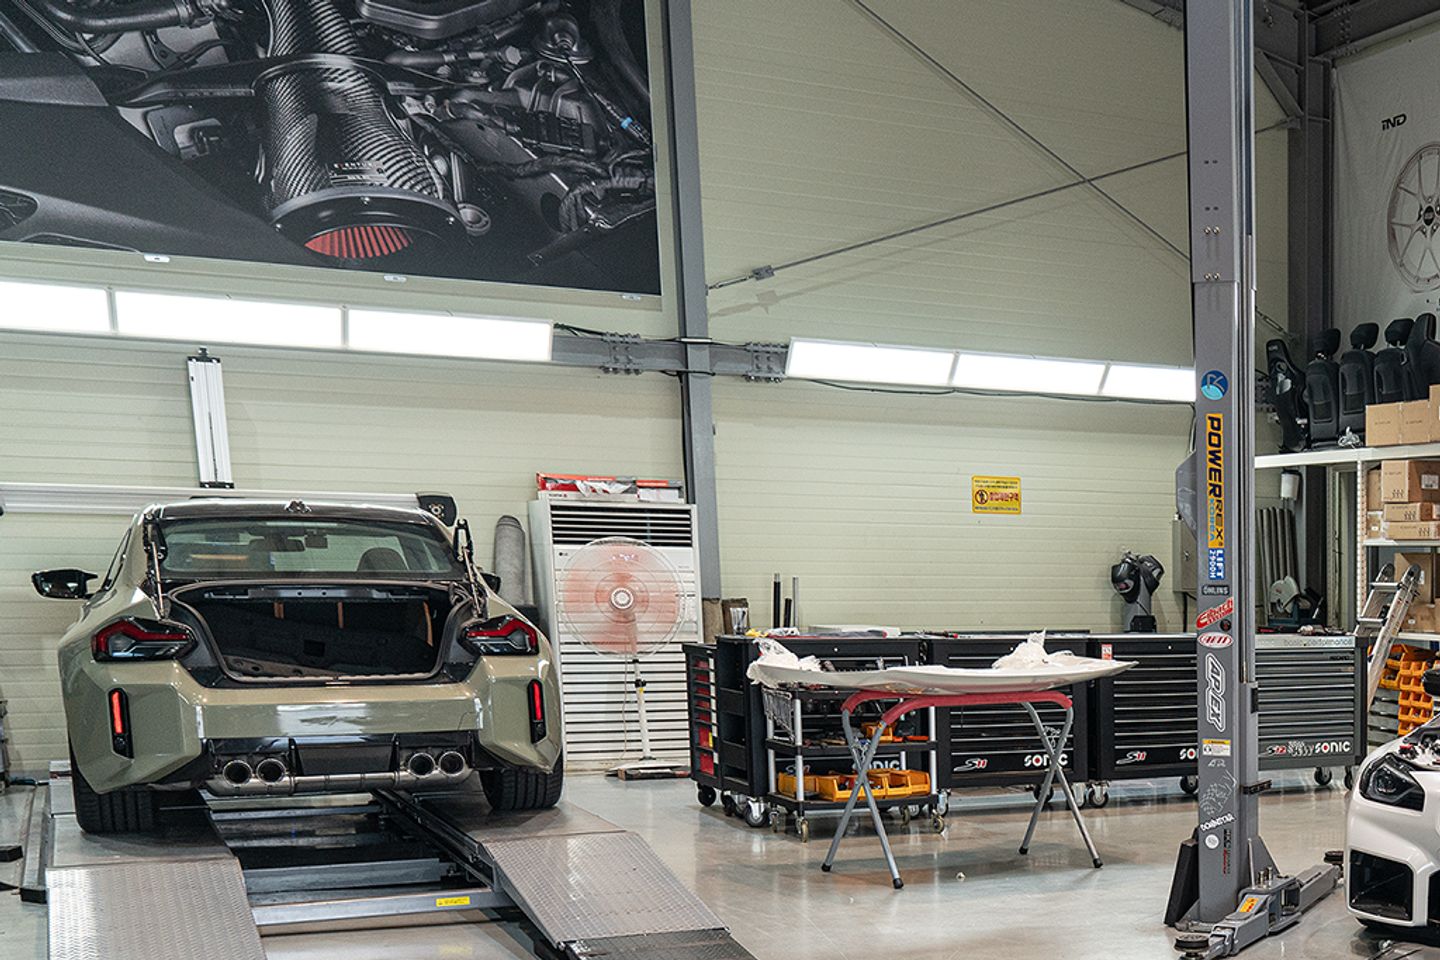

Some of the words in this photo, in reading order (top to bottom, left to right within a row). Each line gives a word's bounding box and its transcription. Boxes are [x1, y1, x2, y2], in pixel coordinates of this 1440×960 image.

[1216, 550, 1224, 578] LIFT
[1315, 741, 1350, 754] SONIC
[1024, 754, 1068, 767] SONC
